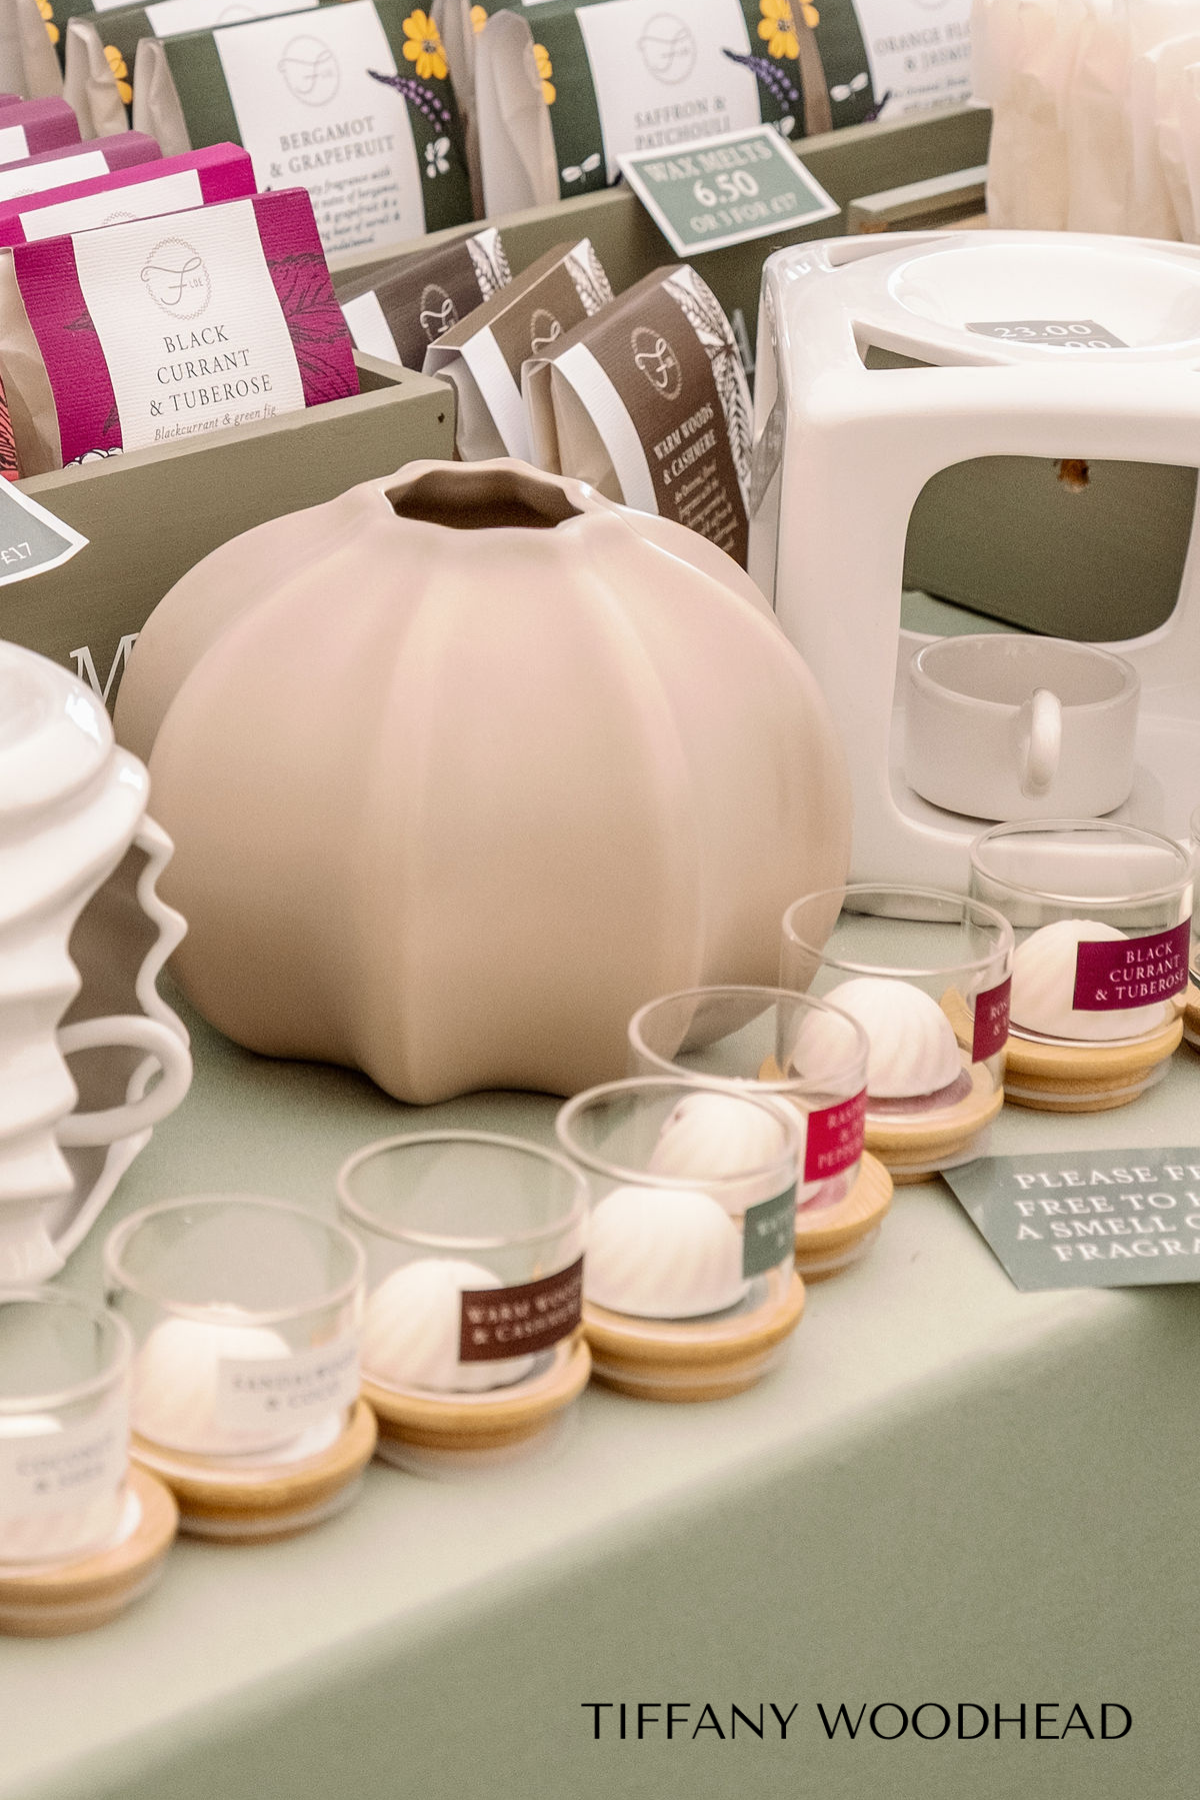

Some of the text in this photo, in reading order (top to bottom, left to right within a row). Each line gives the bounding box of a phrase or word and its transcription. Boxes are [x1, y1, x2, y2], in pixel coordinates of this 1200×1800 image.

[634, 97, 727, 128] SAFFRON &
[280, 116, 375, 152] BERGAMOT
[634, 115, 731, 150] PATCHOULI
[269, 134, 396, 179] & GRAPEFRUIT
[643, 140, 773, 184] WAX MELTS
[693, 169, 760, 208] 6.50
[163, 324, 229, 354] BLACK
[993, 324, 1093, 338] 23.00
[156, 348, 250, 386] CURRANT
[150, 373, 274, 418] & TUBEROSE
[154, 402, 278, 442] Blackcurrant & green fig
[671, 428, 718, 477] CASHMERE
[0, 541, 34, 566] £17
[1109, 953, 1181, 984] CURRANT
[1126, 940, 1174, 965] BLACK
[1095, 968, 1186, 1002] & TUBEROSE
[1013, 1165, 1159, 1191] PLEASE
[1014, 1193, 1116, 1218] FREE
[1119, 1191, 1178, 1212] TO
[1015, 1214, 1178, 1241] A SMELL
